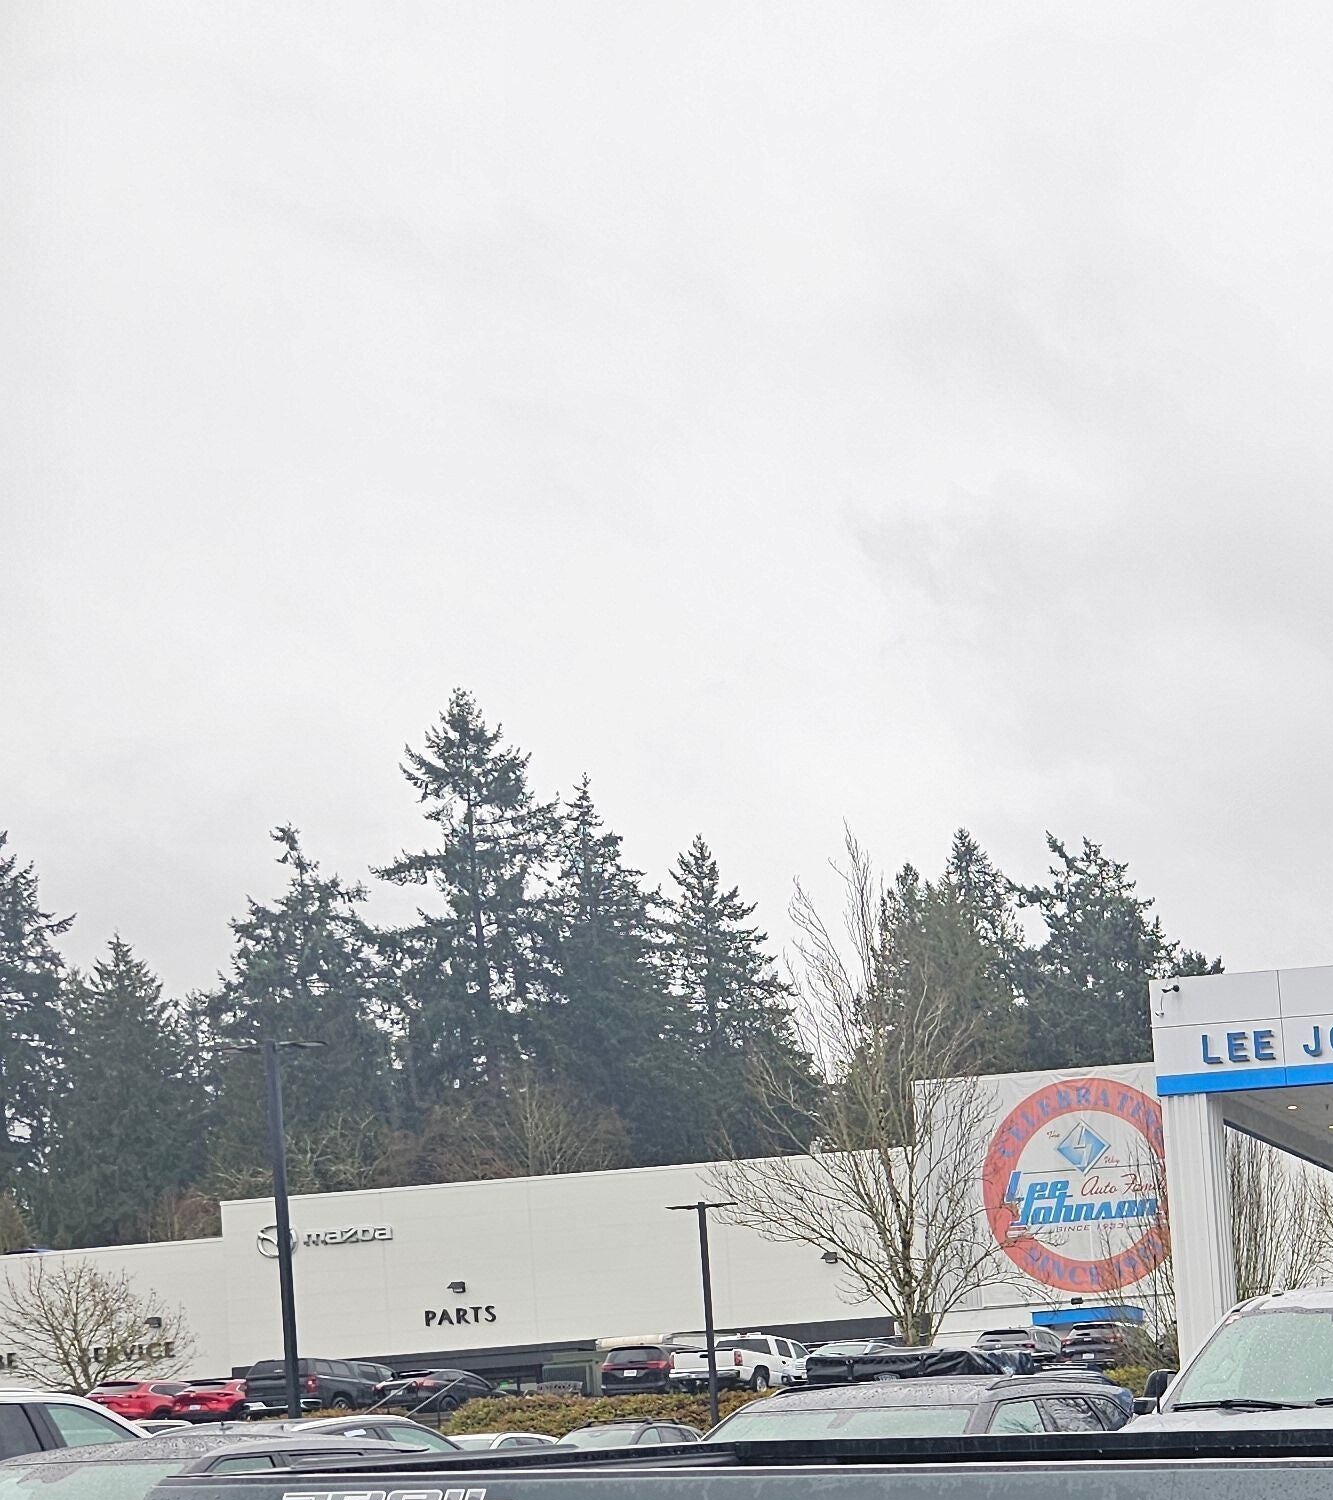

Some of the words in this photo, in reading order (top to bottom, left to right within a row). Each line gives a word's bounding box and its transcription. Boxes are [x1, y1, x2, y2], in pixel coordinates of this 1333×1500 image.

[1201, 1029, 1276, 1064] LEE
[1005, 1171, 1073, 1202] Lee
[1081, 1174, 1118, 1197] Auto
[1009, 1187, 1158, 1226] Johnson
[1056, 1224, 1090, 1233] SINCE
[424, 1305, 497, 1327] PARTS
[81, 1341, 176, 1365] ERVICE
